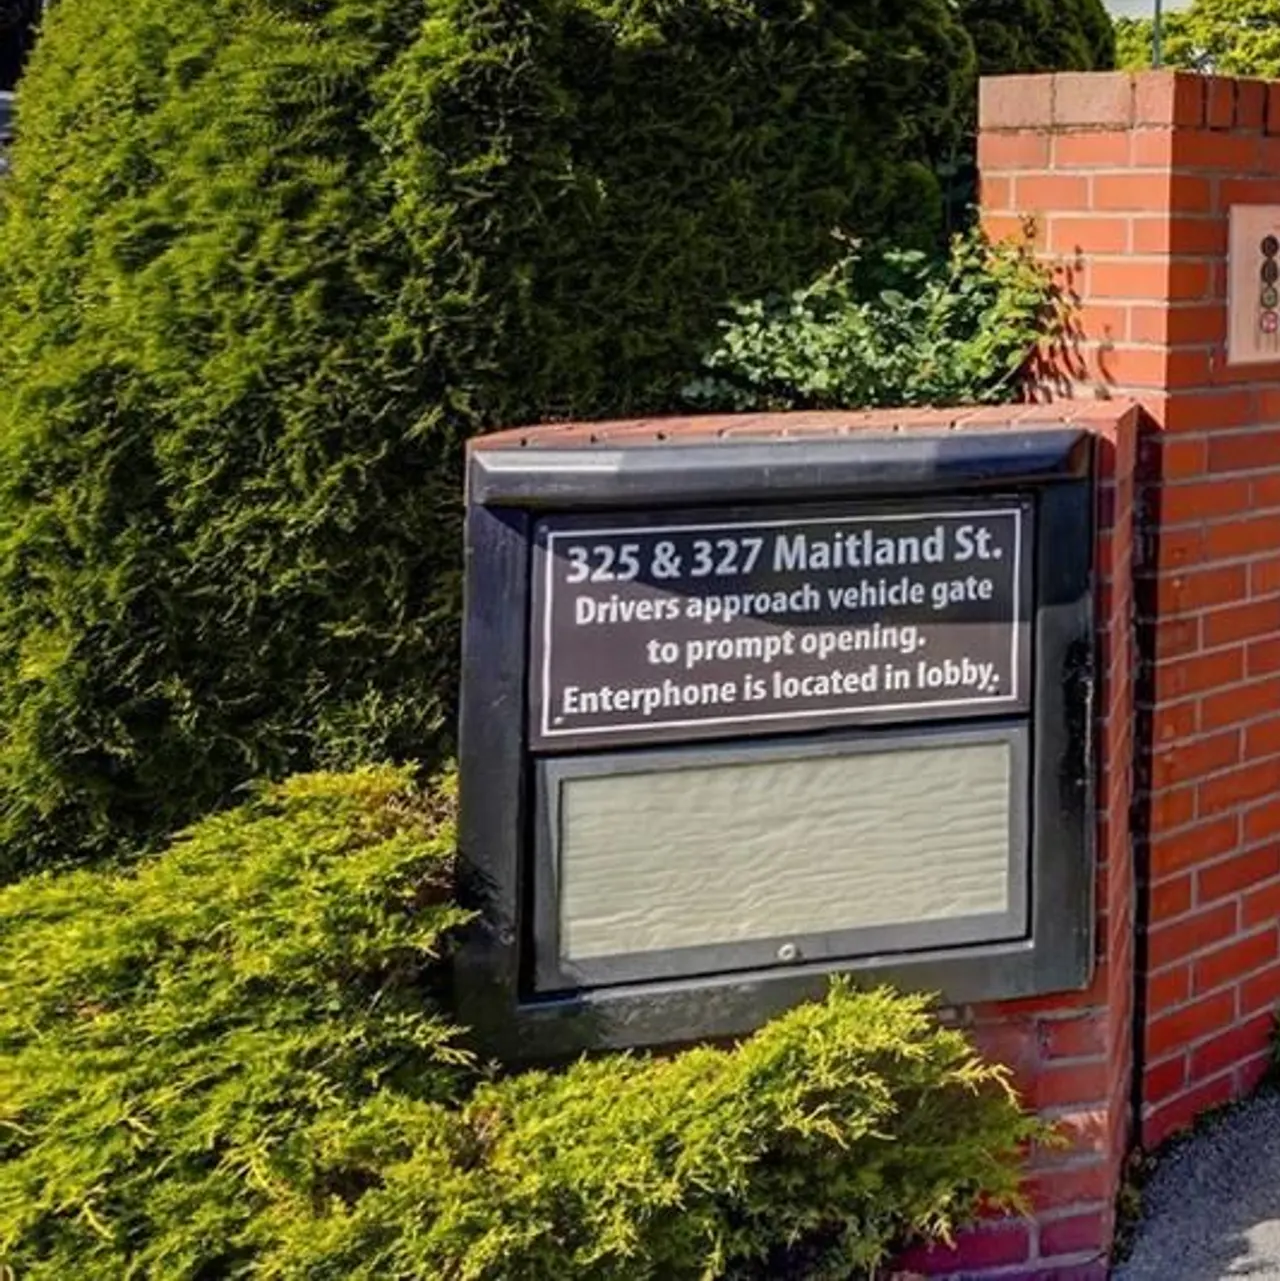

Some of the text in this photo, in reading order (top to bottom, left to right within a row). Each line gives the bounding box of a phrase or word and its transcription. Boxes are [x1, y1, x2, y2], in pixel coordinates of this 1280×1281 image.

[566, 525, 1003, 583] 325 & 327 Maitland St.
[575, 577, 994, 625] Drivers approach vehicle gate
[647, 624, 927, 668] to prompt opening.
[563, 676, 737, 714] Enterphone
[744, 674, 768, 700] is
[773, 665, 879, 699] located
[885, 660, 911, 690] in
